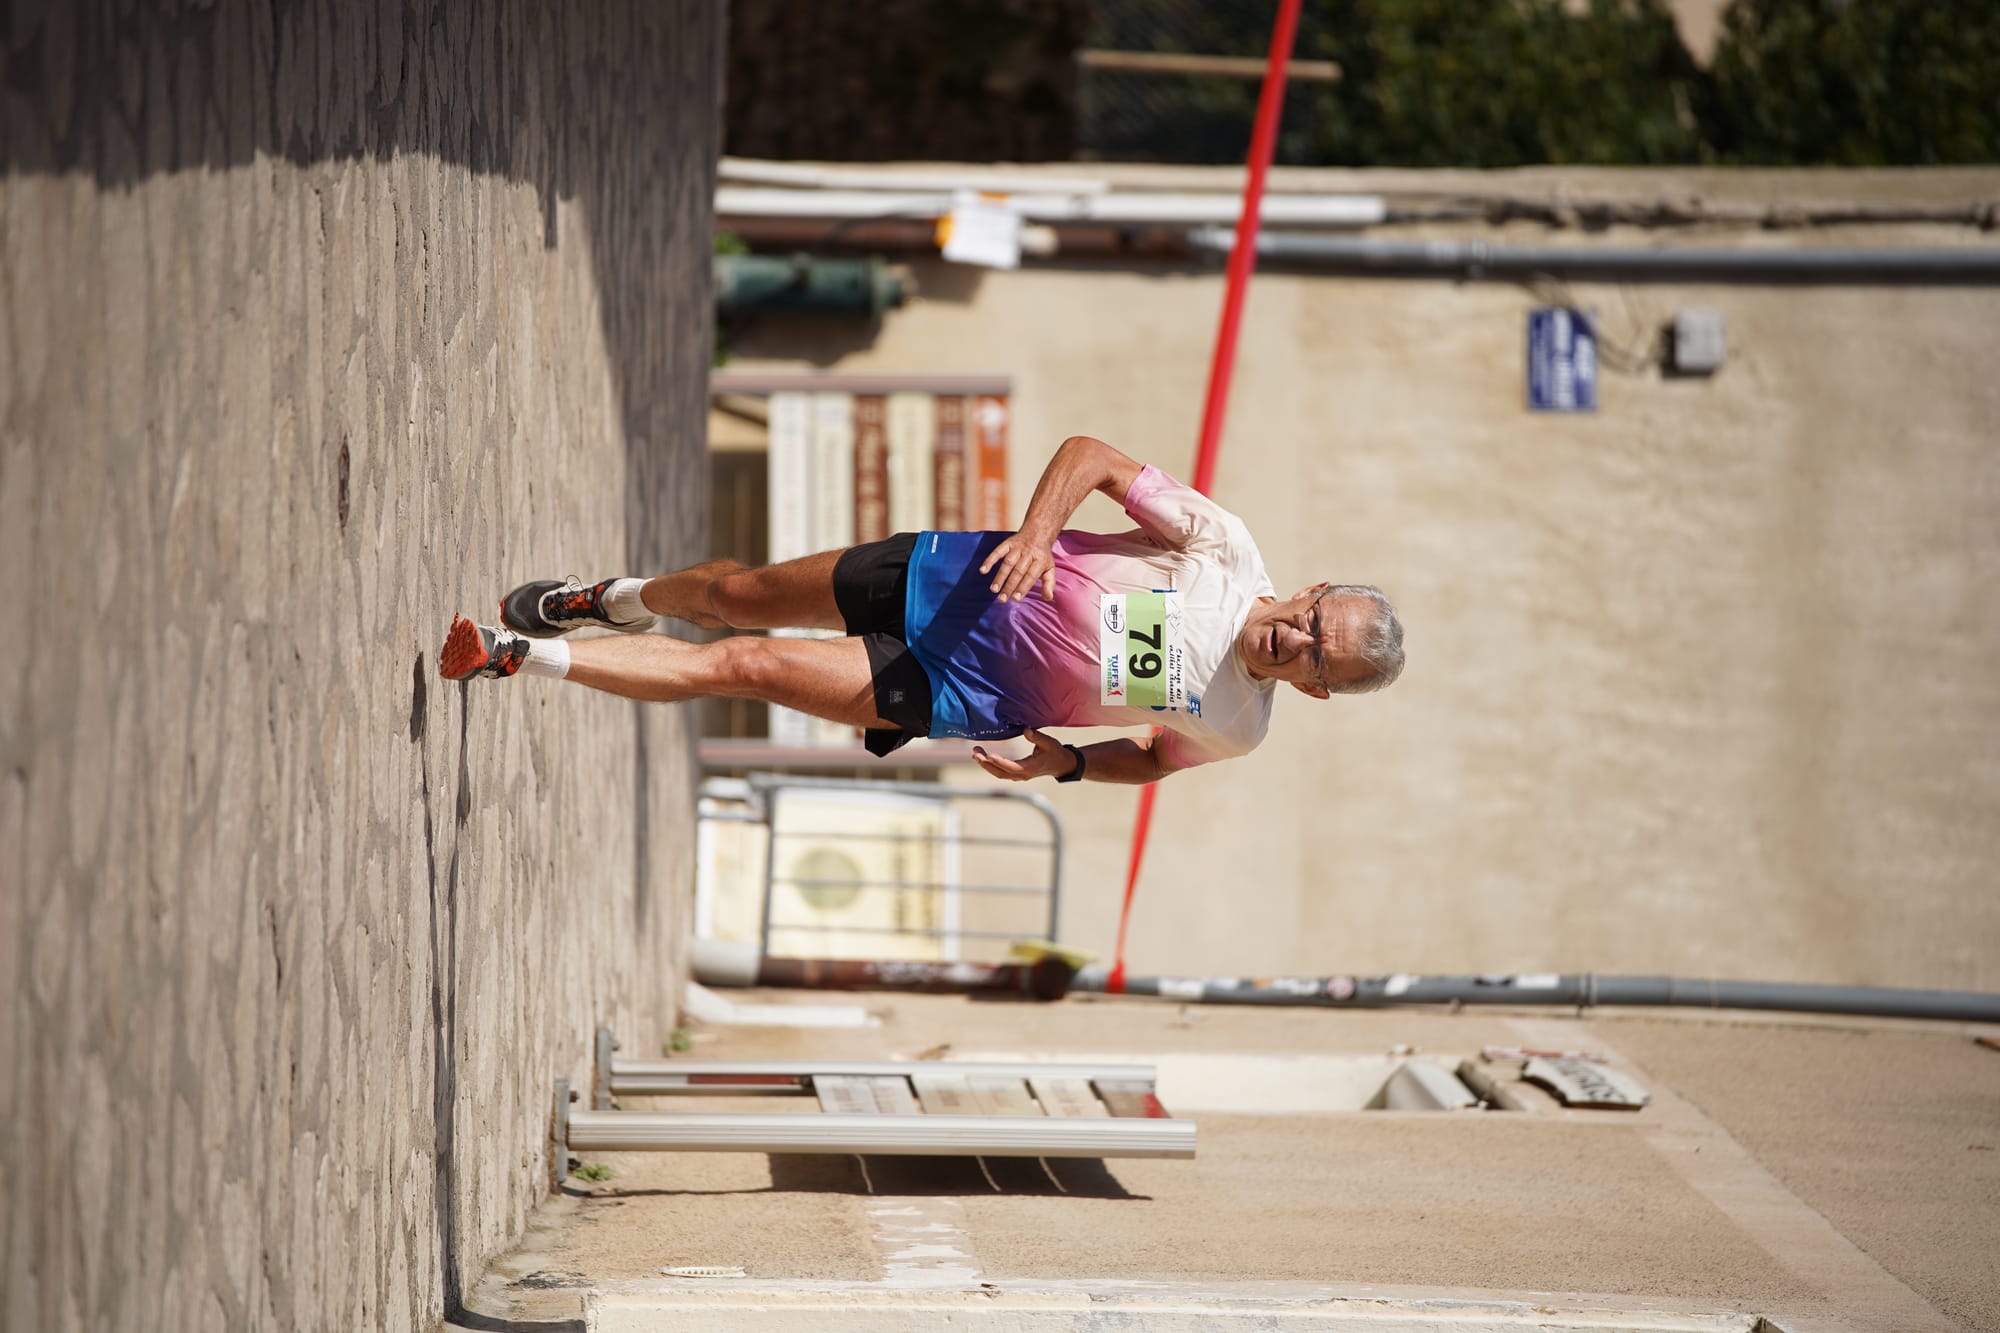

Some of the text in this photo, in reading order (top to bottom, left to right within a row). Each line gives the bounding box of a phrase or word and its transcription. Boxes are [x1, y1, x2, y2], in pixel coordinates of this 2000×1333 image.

[1129, 624, 1162, 679] 79
[1174, 648, 1183, 684] Challenge
[1111, 654, 1119, 688] TUFF'S
